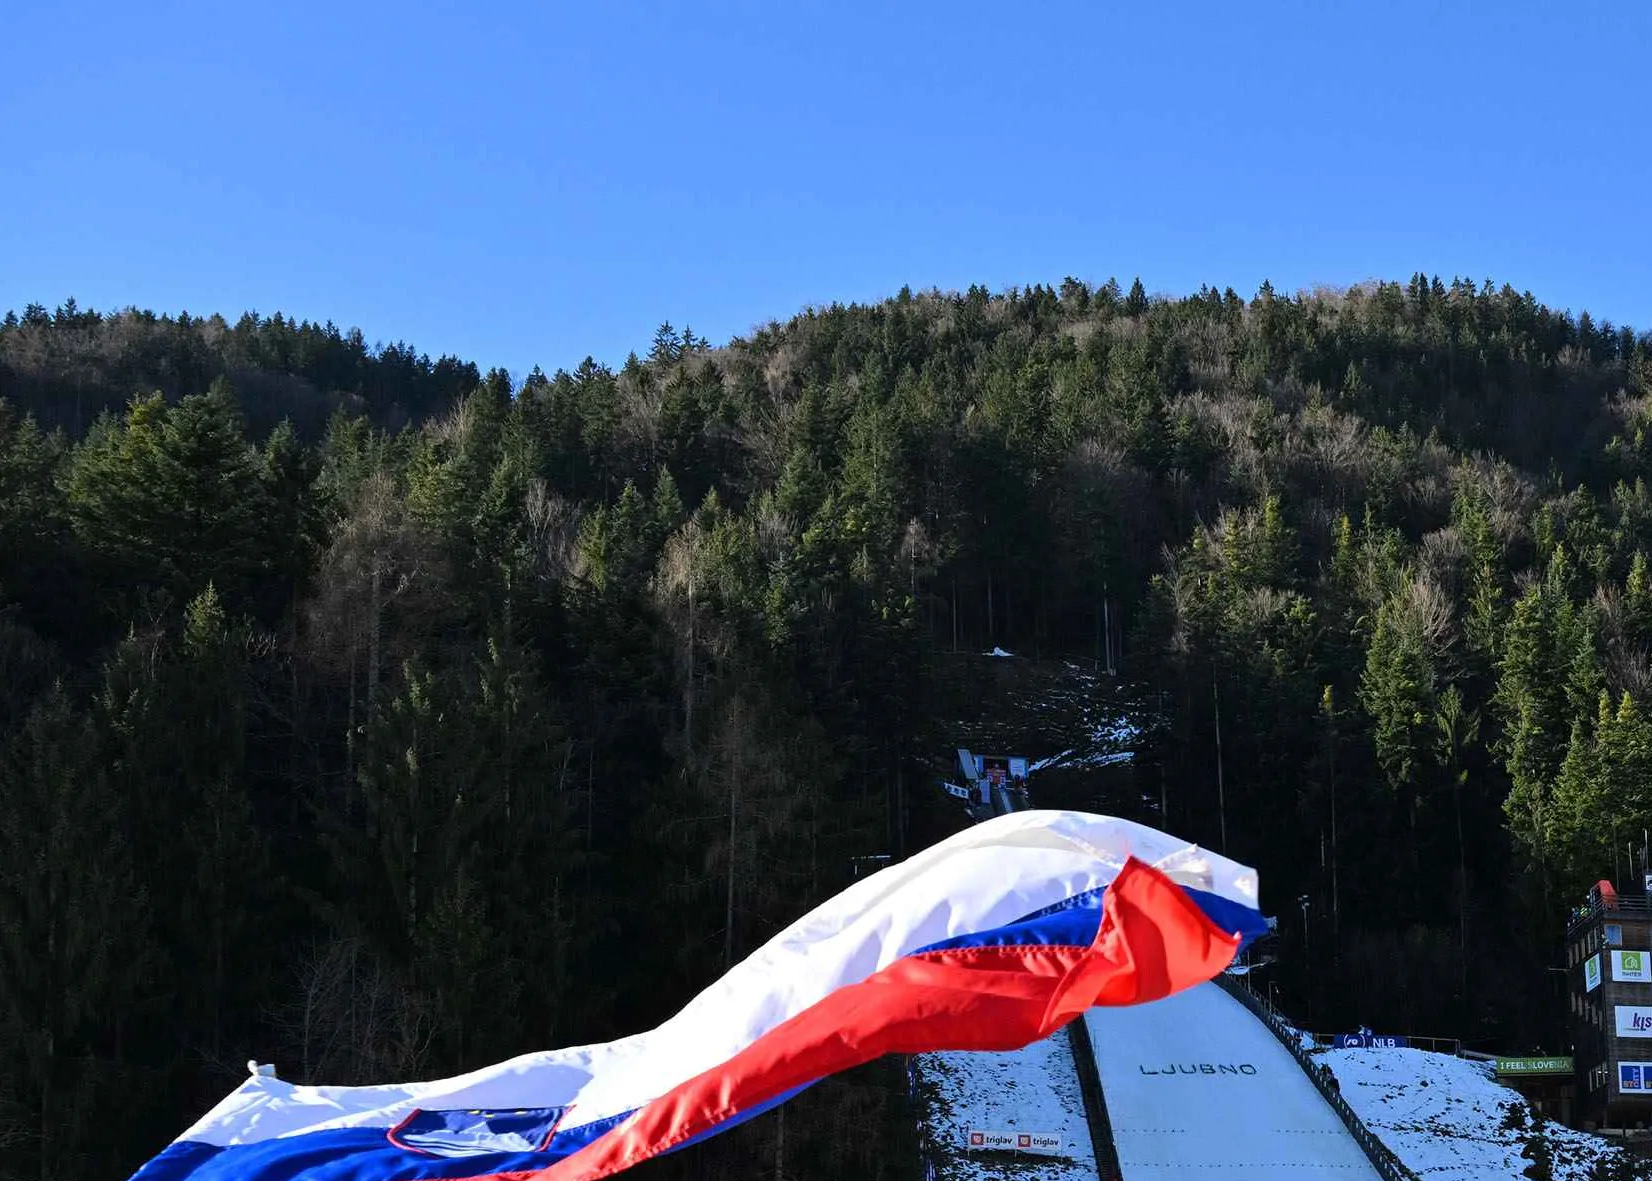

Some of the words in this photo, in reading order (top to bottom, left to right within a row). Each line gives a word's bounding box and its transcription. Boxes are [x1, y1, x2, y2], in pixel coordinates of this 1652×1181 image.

[1373, 1038, 1396, 1049] NLB
[1139, 1063, 1258, 1076] LJUBNO
[1506, 1062, 1526, 1070] FEEL
[986, 1136, 1012, 1145] triglav
[1033, 1138, 1058, 1147] triglav
